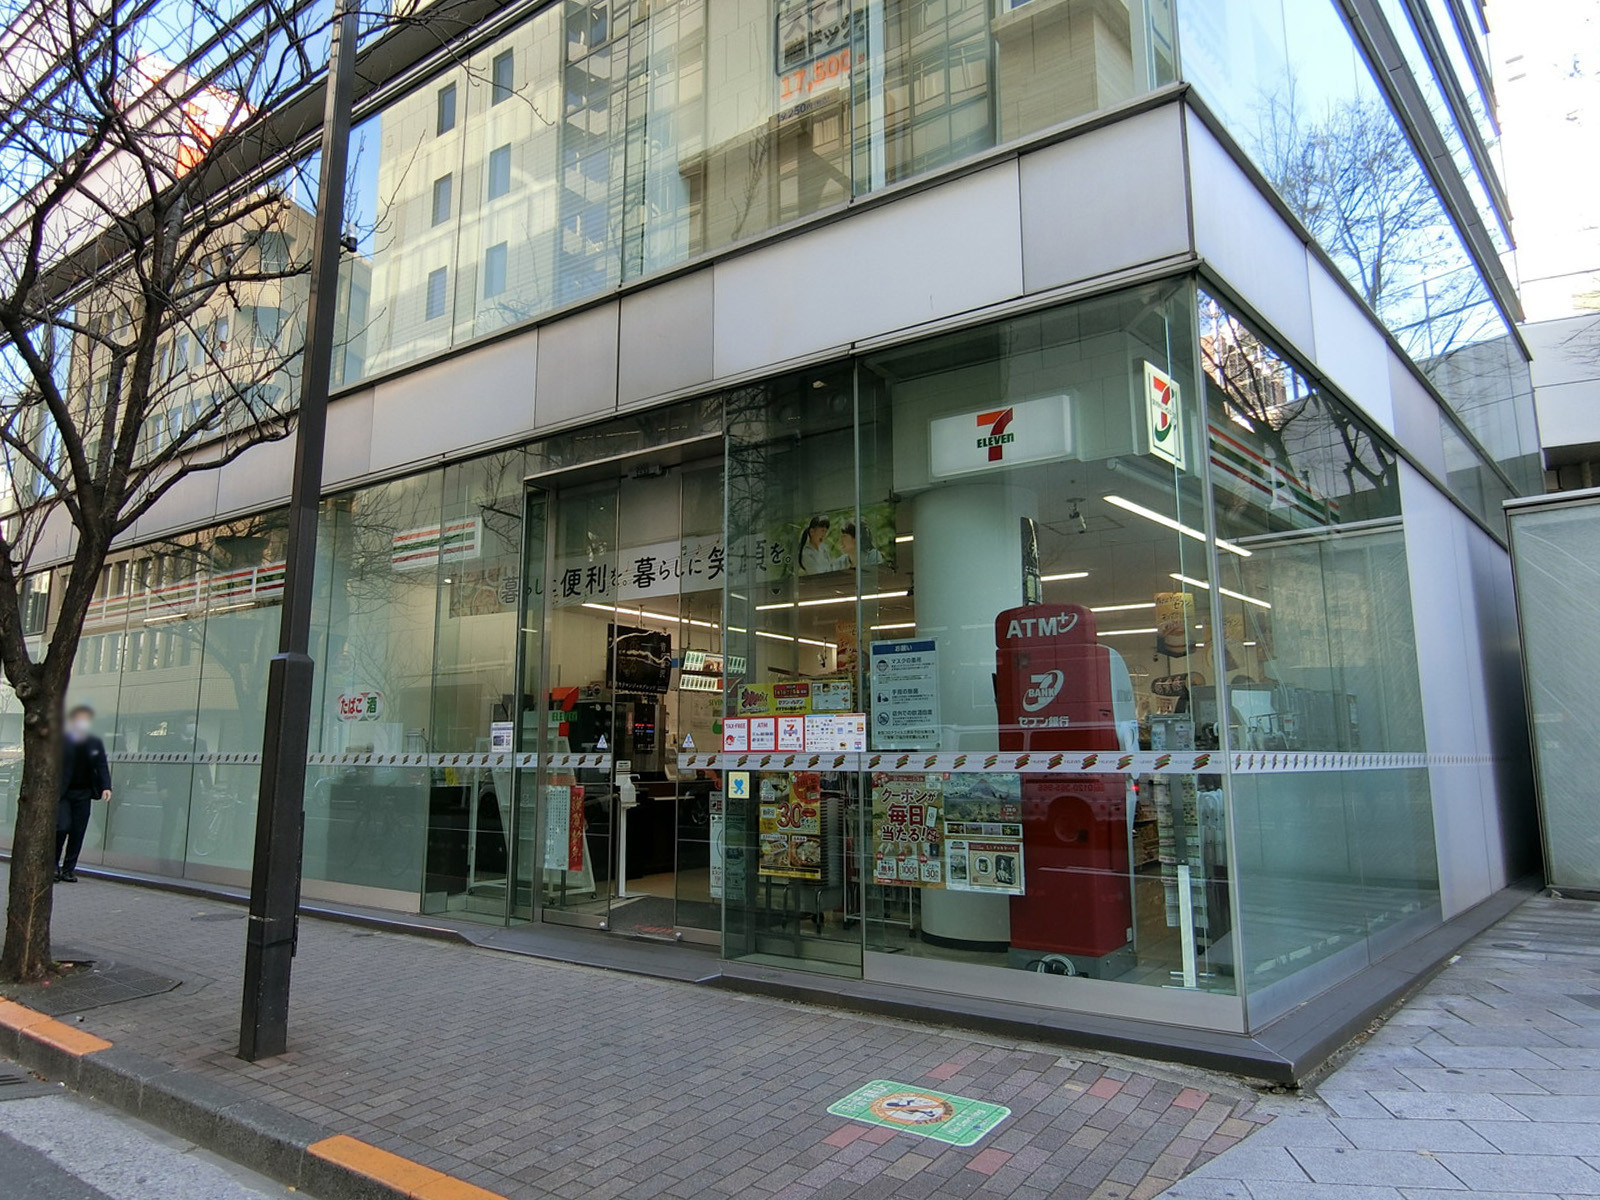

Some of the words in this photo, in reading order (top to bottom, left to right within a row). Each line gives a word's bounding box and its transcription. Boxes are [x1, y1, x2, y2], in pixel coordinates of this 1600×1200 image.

[1028, 688, 1056, 698] BANK
[340, 697, 363, 714] たばこ
[366, 696, 378, 714] 酒
[1018, 716, 1069, 728] セブン銀行
[882, 787, 936, 803] クーポンが
[777, 802, 803, 828] 30
[888, 803, 924, 826] 毎日
